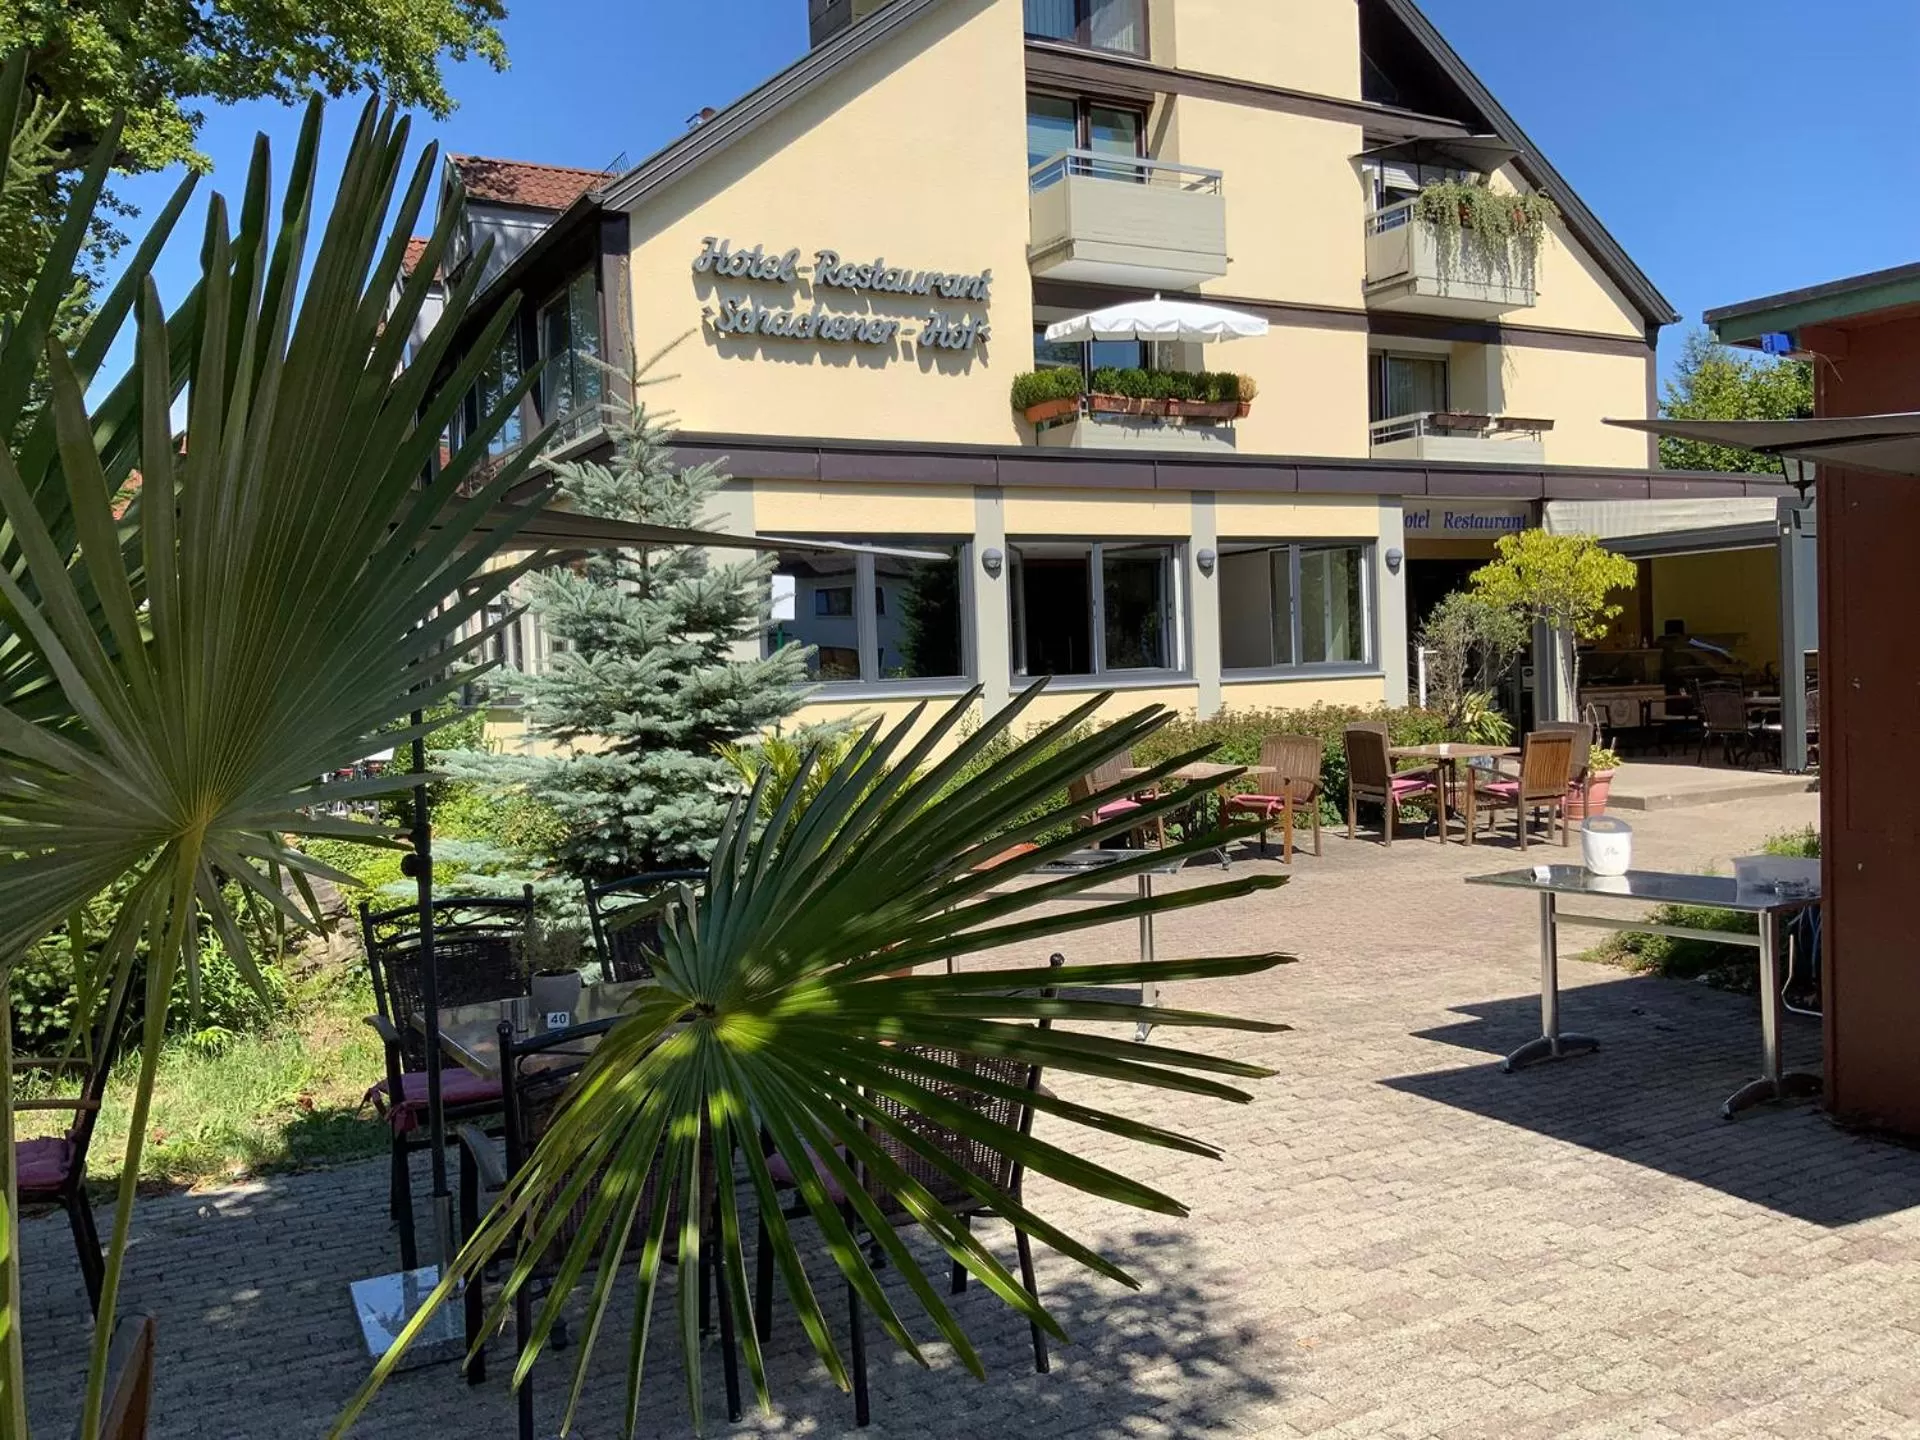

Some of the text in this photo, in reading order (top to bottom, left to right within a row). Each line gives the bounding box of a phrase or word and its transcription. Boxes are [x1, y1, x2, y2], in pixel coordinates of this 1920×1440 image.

[692, 236, 993, 301] Hotel-Restaurant
[1403, 509, 1527, 530] otel Restaurant
[551, 1013, 567, 1025] 40
